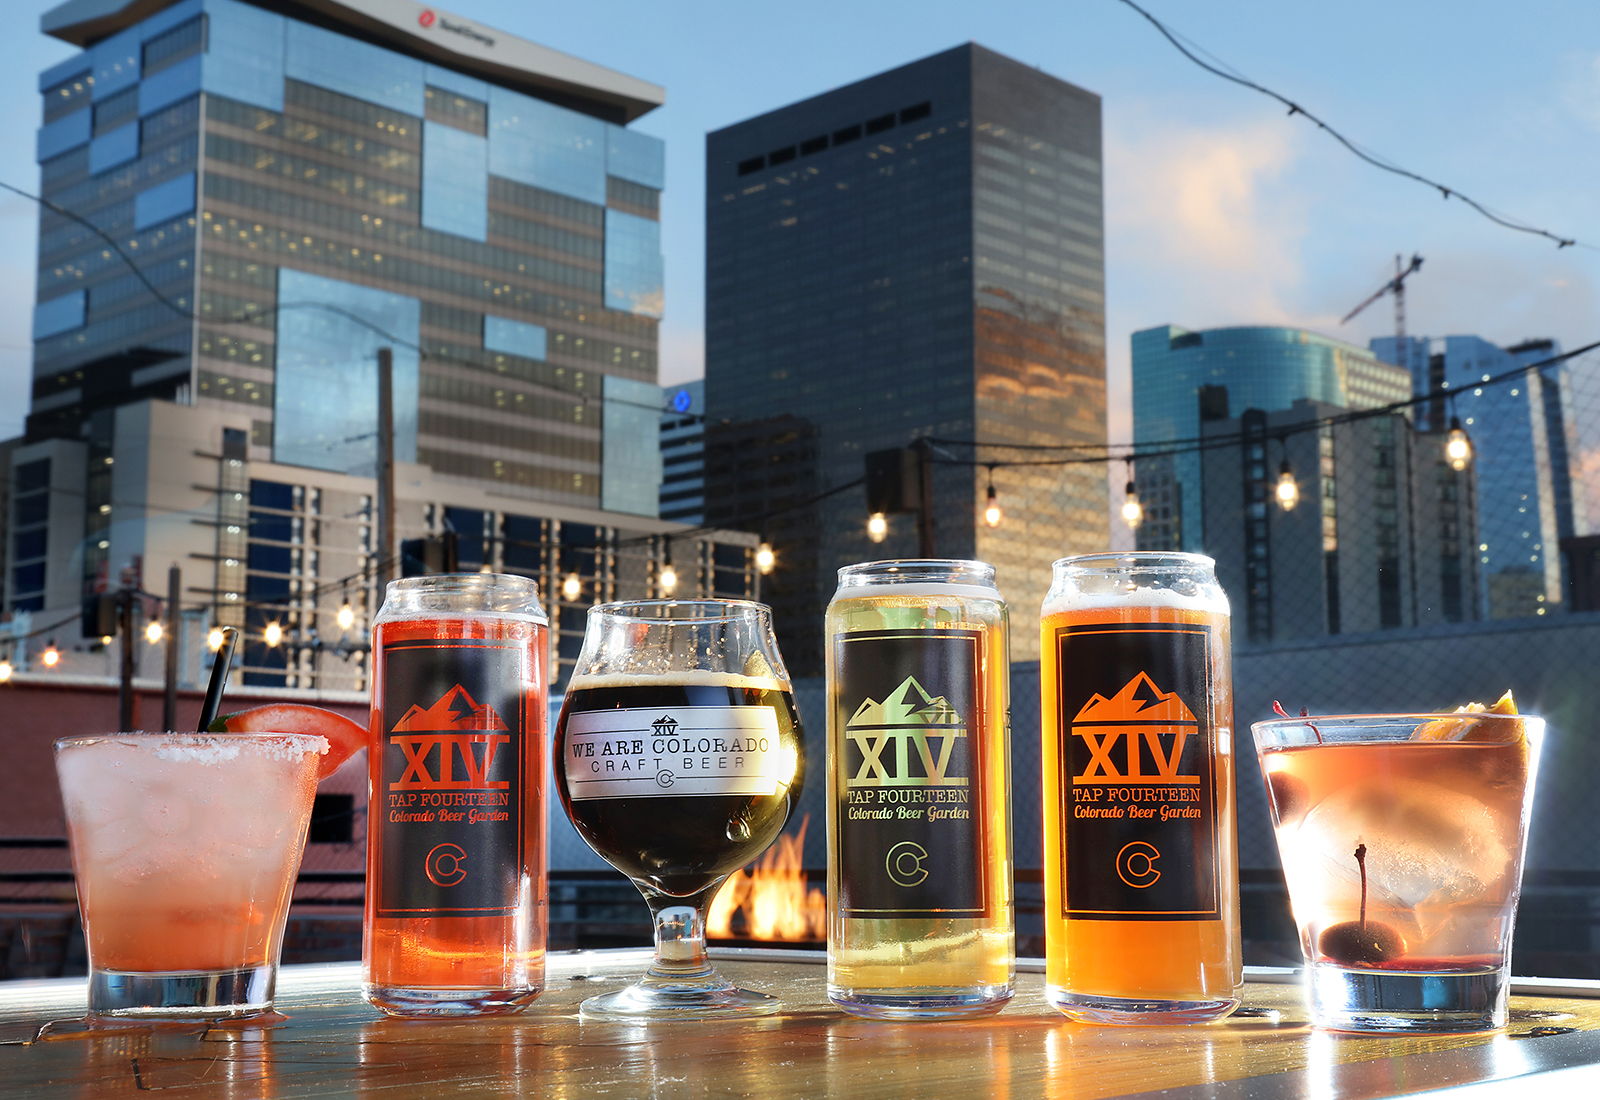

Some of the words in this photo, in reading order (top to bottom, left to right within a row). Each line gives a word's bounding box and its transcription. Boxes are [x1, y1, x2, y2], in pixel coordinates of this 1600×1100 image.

[651, 724, 679, 736] XIV
[572, 742, 595, 758] WE
[601, 740, 643, 756] ARE
[652, 738, 769, 754] COLORADO
[1072, 725, 1200, 784] XIV
[389, 734, 510, 790] XIV
[591, 758, 662, 773] CRAFT
[683, 757, 745, 769] BEER
[846, 729, 968, 786] XIV
[389, 793, 417, 807] TAP
[420, 793, 509, 807] FOURTEEN
[847, 790, 874, 804] TAP
[877, 790, 969, 804] FOURTEEN
[1073, 788, 1102, 802] TAP
[1107, 788, 1201, 802] FOURTEEN
[389, 810, 435, 823] Colorado
[438, 809, 465, 822] Beer
[468, 808, 509, 824] Garden
[848, 807, 893, 820] Colorado
[896, 806, 924, 820] Beer
[927, 806, 969, 822] Garden
[1074, 805, 1124, 819] Colorado
[1127, 805, 1157, 819] Beer
[1160, 805, 1201, 822] Garden
